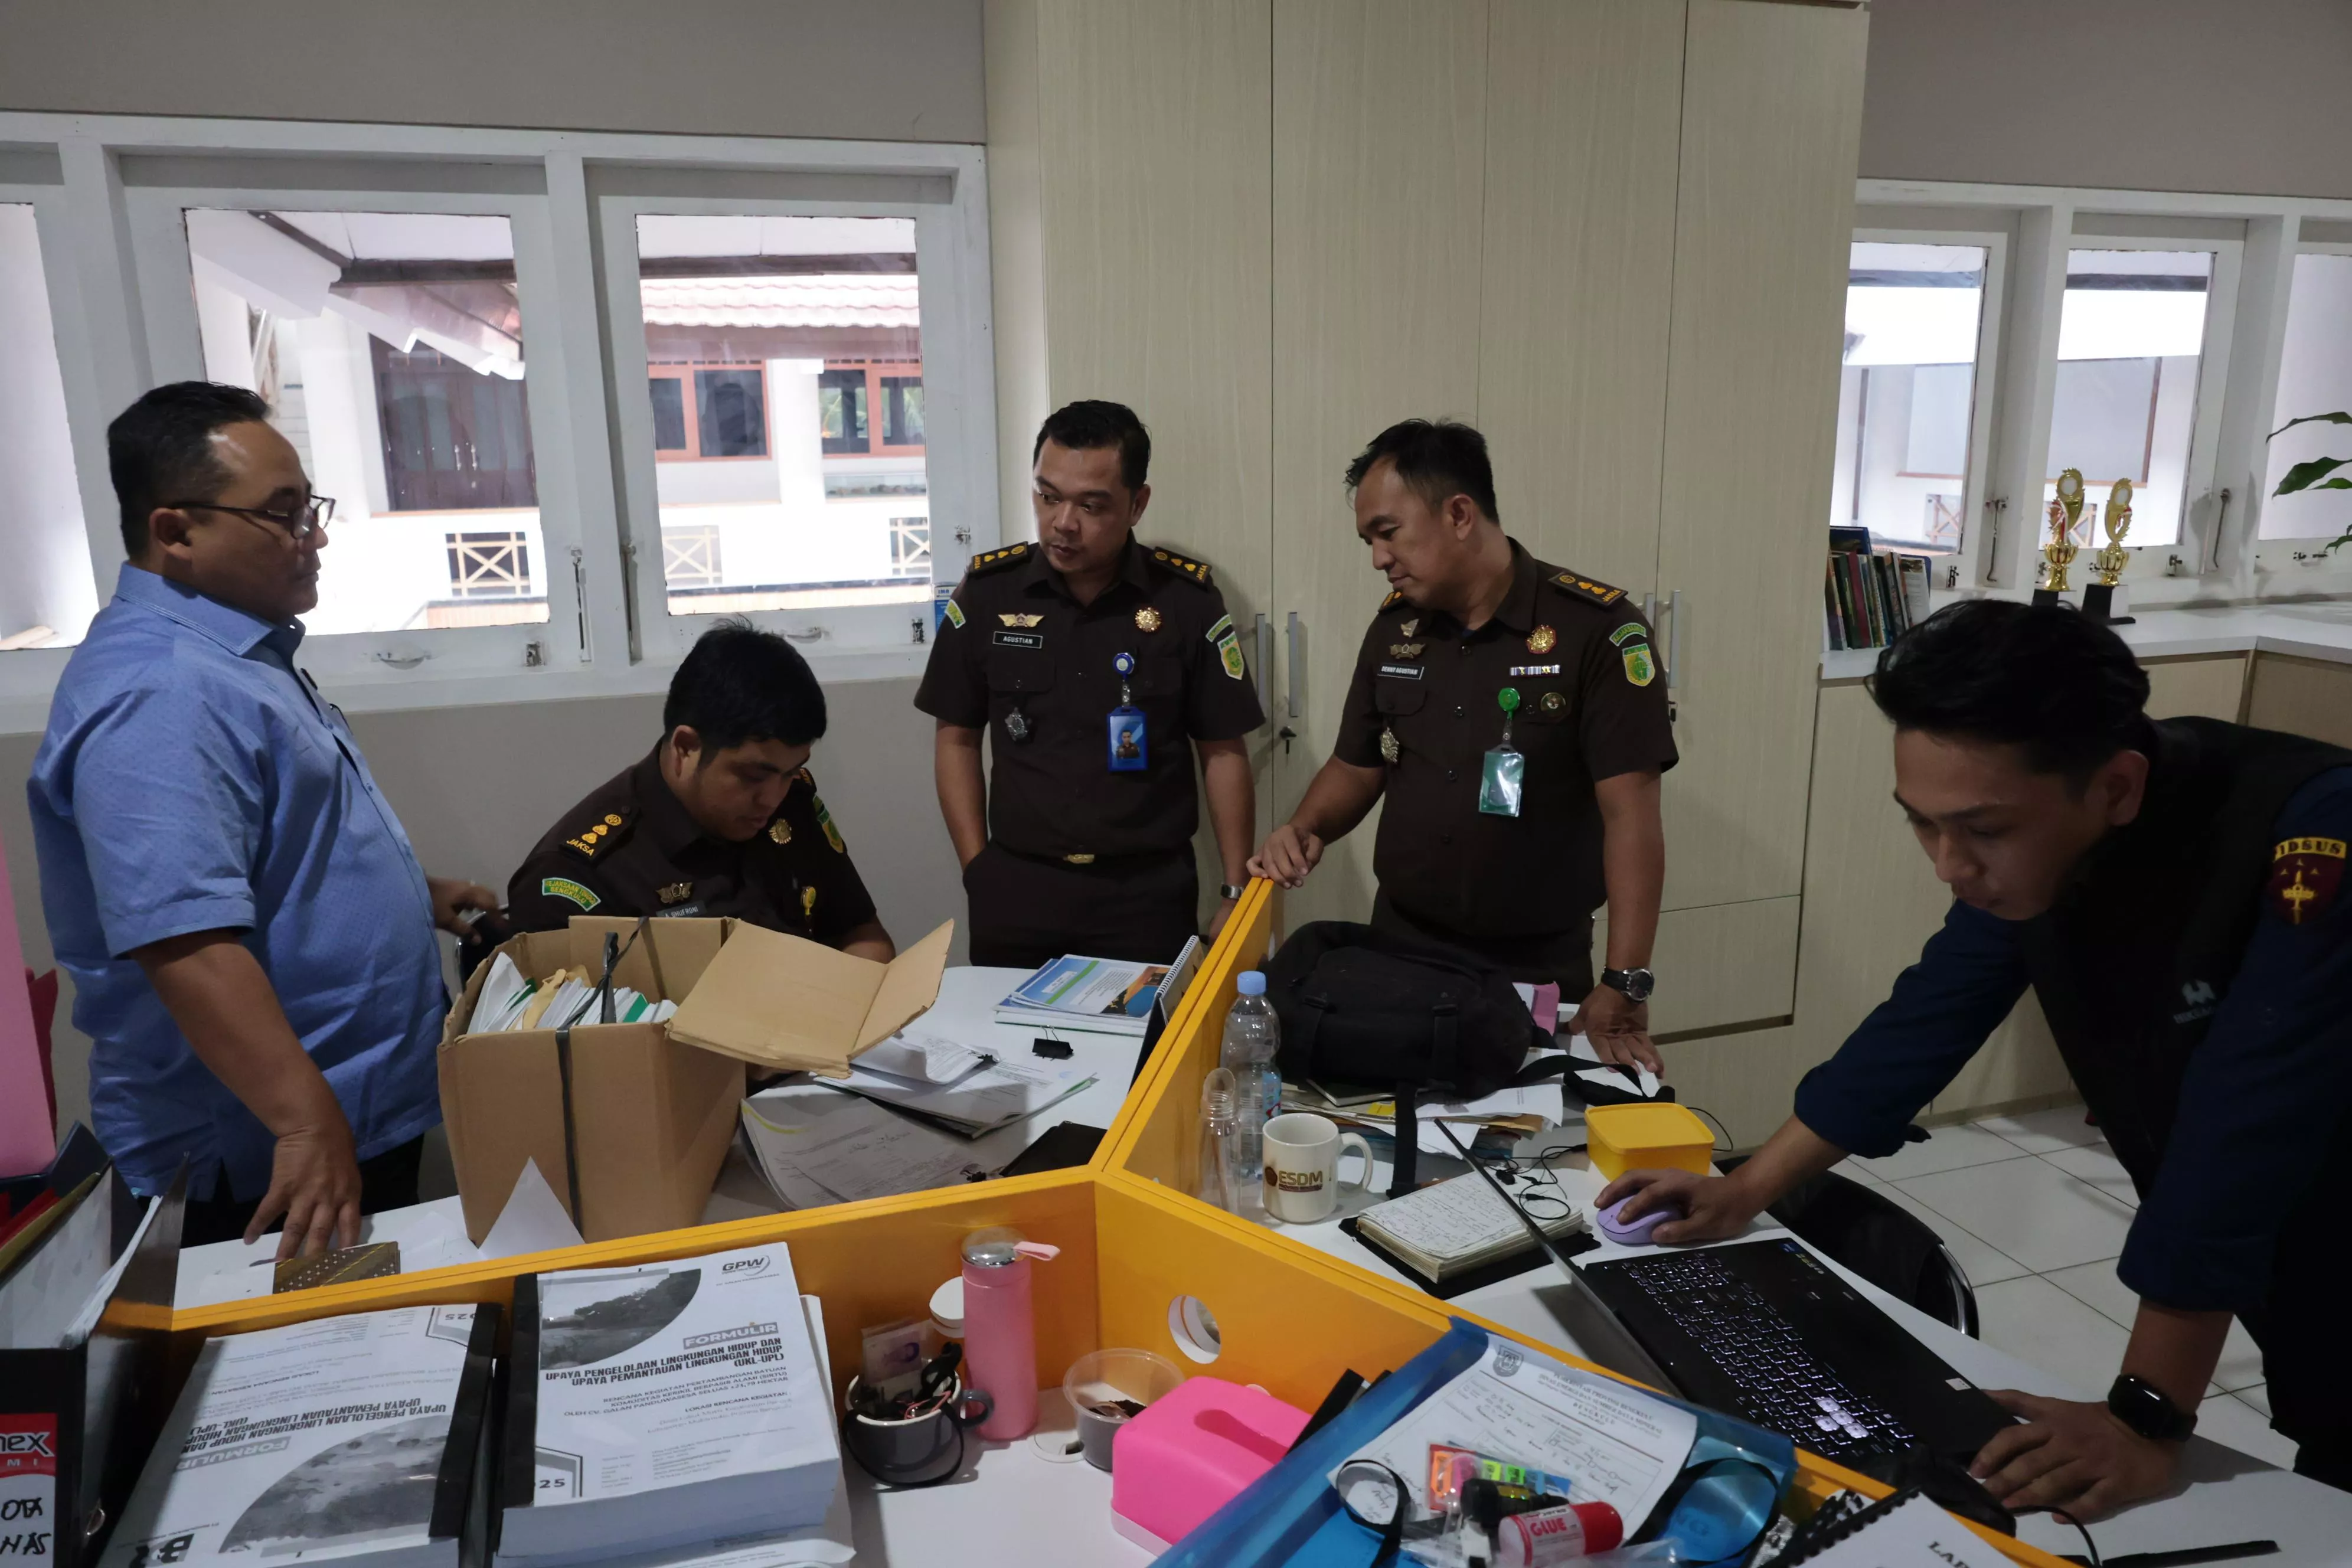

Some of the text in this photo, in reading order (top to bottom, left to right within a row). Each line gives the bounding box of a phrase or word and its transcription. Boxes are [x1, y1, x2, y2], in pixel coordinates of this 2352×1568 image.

[1003, 636, 1033, 644] AGUSTIAN
[567, 838, 595, 857] JAKSA
[2276, 839, 2341, 856] IDSUS
[550, 887, 586, 904] BENGKULU
[1279, 1171, 1323, 1185] ESDM
[722, 1257, 765, 1272] GPW
[685, 1324, 777, 1347] FORMULIR
[545, 1337, 781, 1380] UPAYA PENGELOLAAN LINGKUNGAN HIDUP DAN
[572, 1345, 782, 1386] UPAYA PEMANTAUAN LINGKUNGAN HIDUP
[734, 1353, 785, 1367] (UKL-UPL)
[603, 1393, 642, 1403] RENCANA
[644, 1384, 685, 1396] KEGIATAN
[687, 1371, 753, 1387] PERTAMBANGAN
[384, 1398, 421, 1409] UPAYA
[610, 1394, 661, 1407] KOMODITAS
[685, 1403, 712, 1412] LOKASI
[713, 1397, 750, 1407] RENCANA
[750, 1391, 788, 1401] KEGIATAN
[300, 1403, 381, 1419] PEMANTAUAN
[326, 1409, 406, 1425] PENGELOLAAN
[409, 1404, 446, 1415] UPAYA
[225, 1414, 298, 1435] LINGKUNGAN
[248, 1419, 322, 1439] LINGKUNGAN
[210, 1433, 246, 1447] HIDUP
[1530, 1517, 1567, 1537] GLUE
